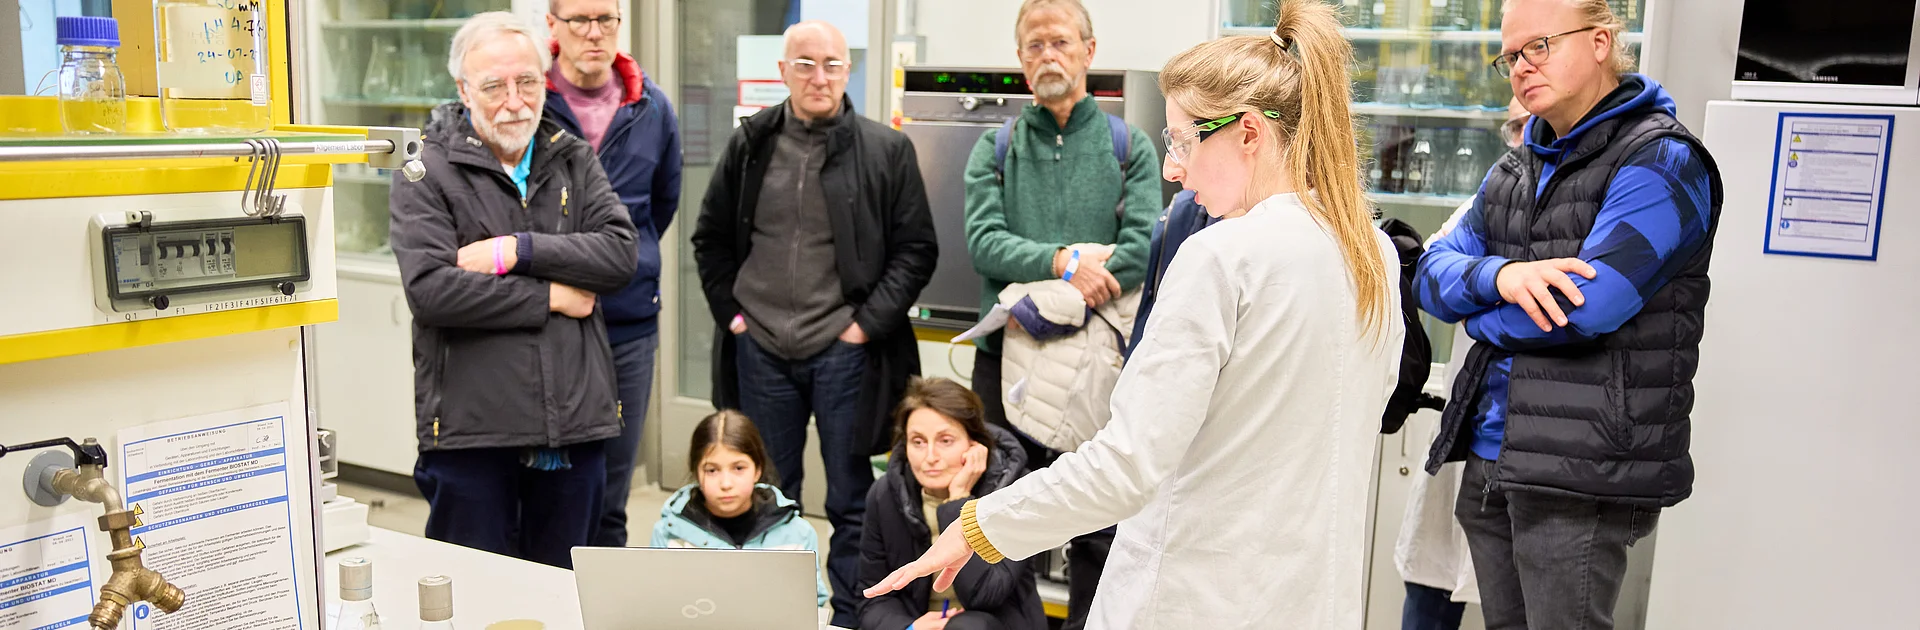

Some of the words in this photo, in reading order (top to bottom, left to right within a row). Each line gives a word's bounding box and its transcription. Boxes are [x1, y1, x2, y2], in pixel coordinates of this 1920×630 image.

[167, 429, 226, 443] BETRIEBSANWEISUNG
[154, 474, 185, 484] Fermentation
[206, 466, 228, 474] Fermenter
[229, 461, 250, 469] BIOSTAT
[158, 465, 193, 476] EINRICHTUNG
[223, 454, 252, 463] APPARATUR
[158, 486, 186, 495] GEFAHREN
[200, 479, 220, 487] MENSCH
[233, 471, 255, 480] UMWELT
[148, 514, 203, 531] SCHUTZMASSNAHMEN
[217, 500, 268, 514] VERHALTENSREGELN
[12, 572, 49, 585] APPARATUR
[21, 580, 46, 591] BIOSTAT
[27, 591, 52, 602] UMWELT
